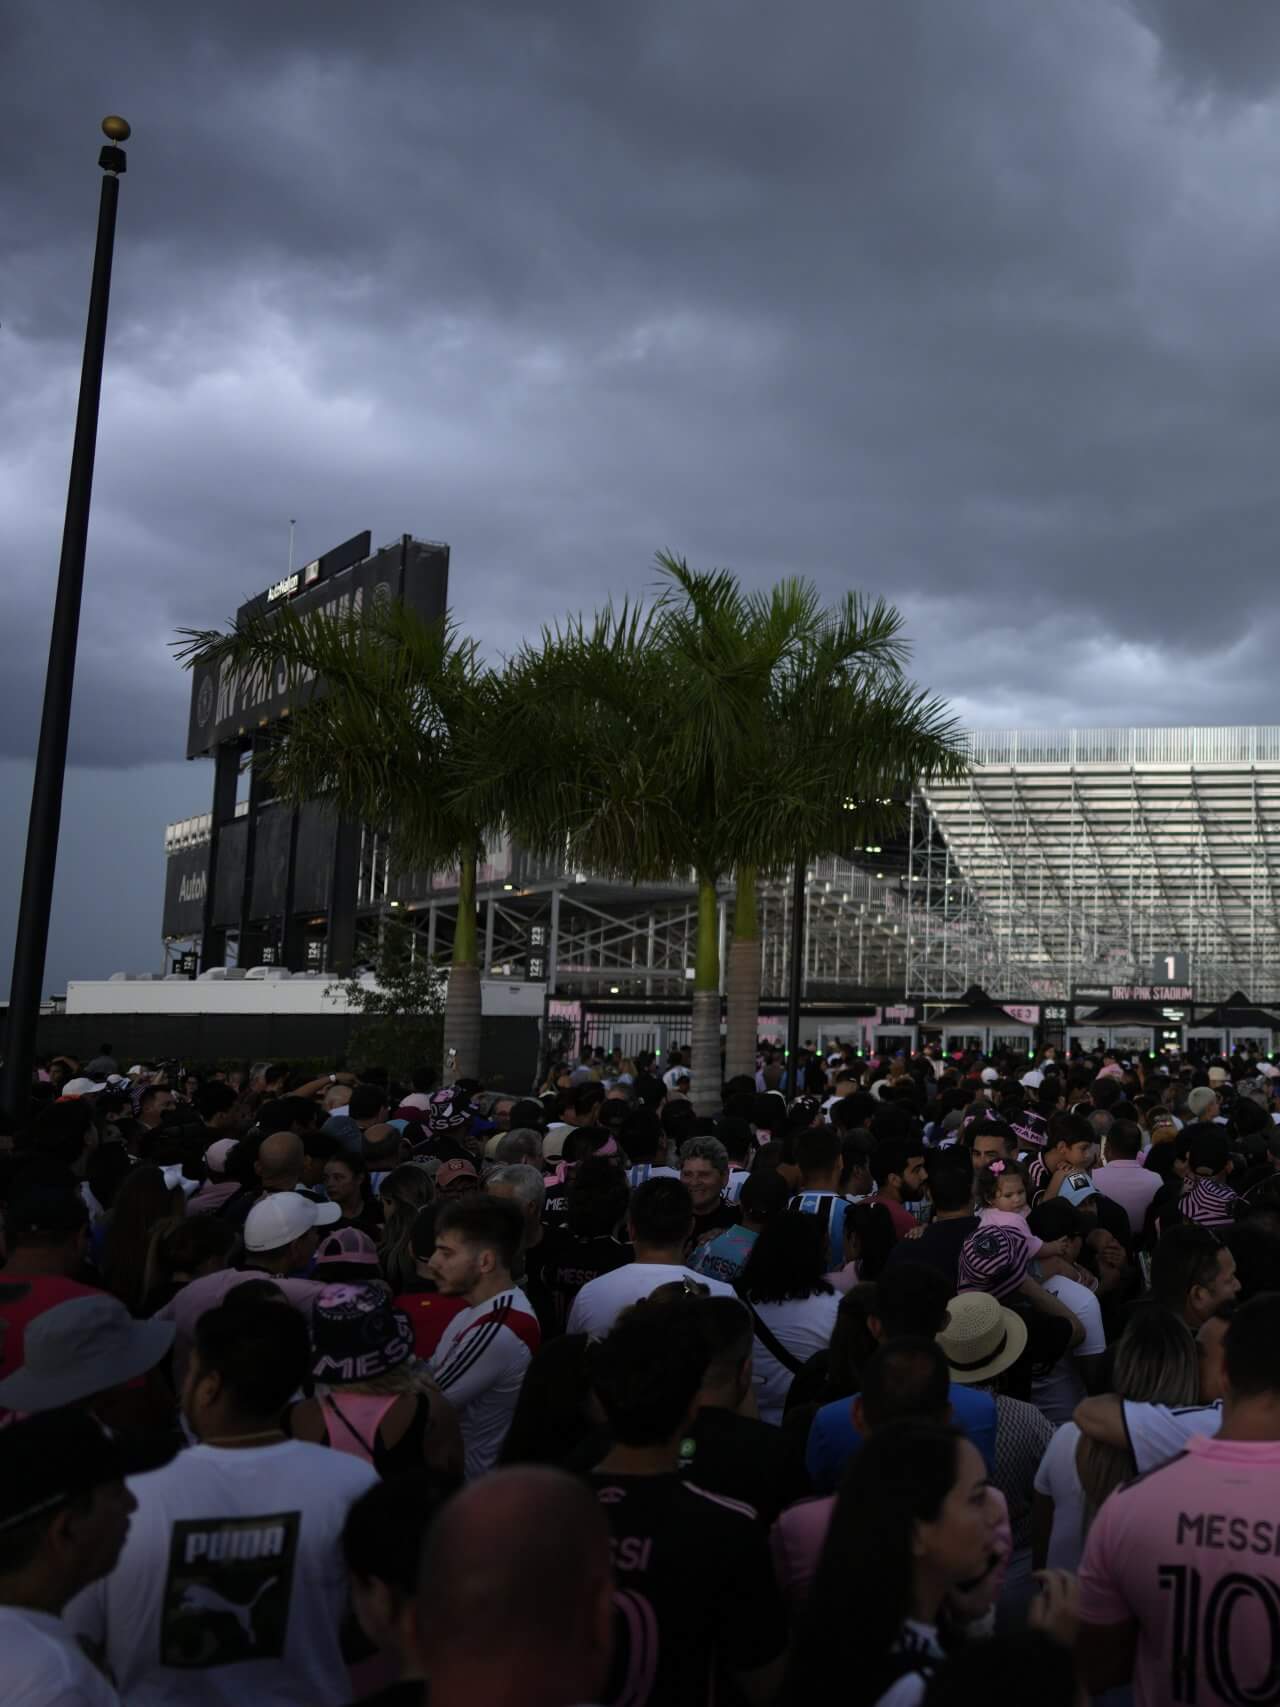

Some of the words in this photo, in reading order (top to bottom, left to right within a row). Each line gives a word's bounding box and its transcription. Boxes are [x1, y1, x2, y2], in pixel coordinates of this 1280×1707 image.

[1164, 955, 1176, 980] 1
[1152, 986, 1193, 1000] STADIUM
[184, 1525, 287, 1565] PUMA
